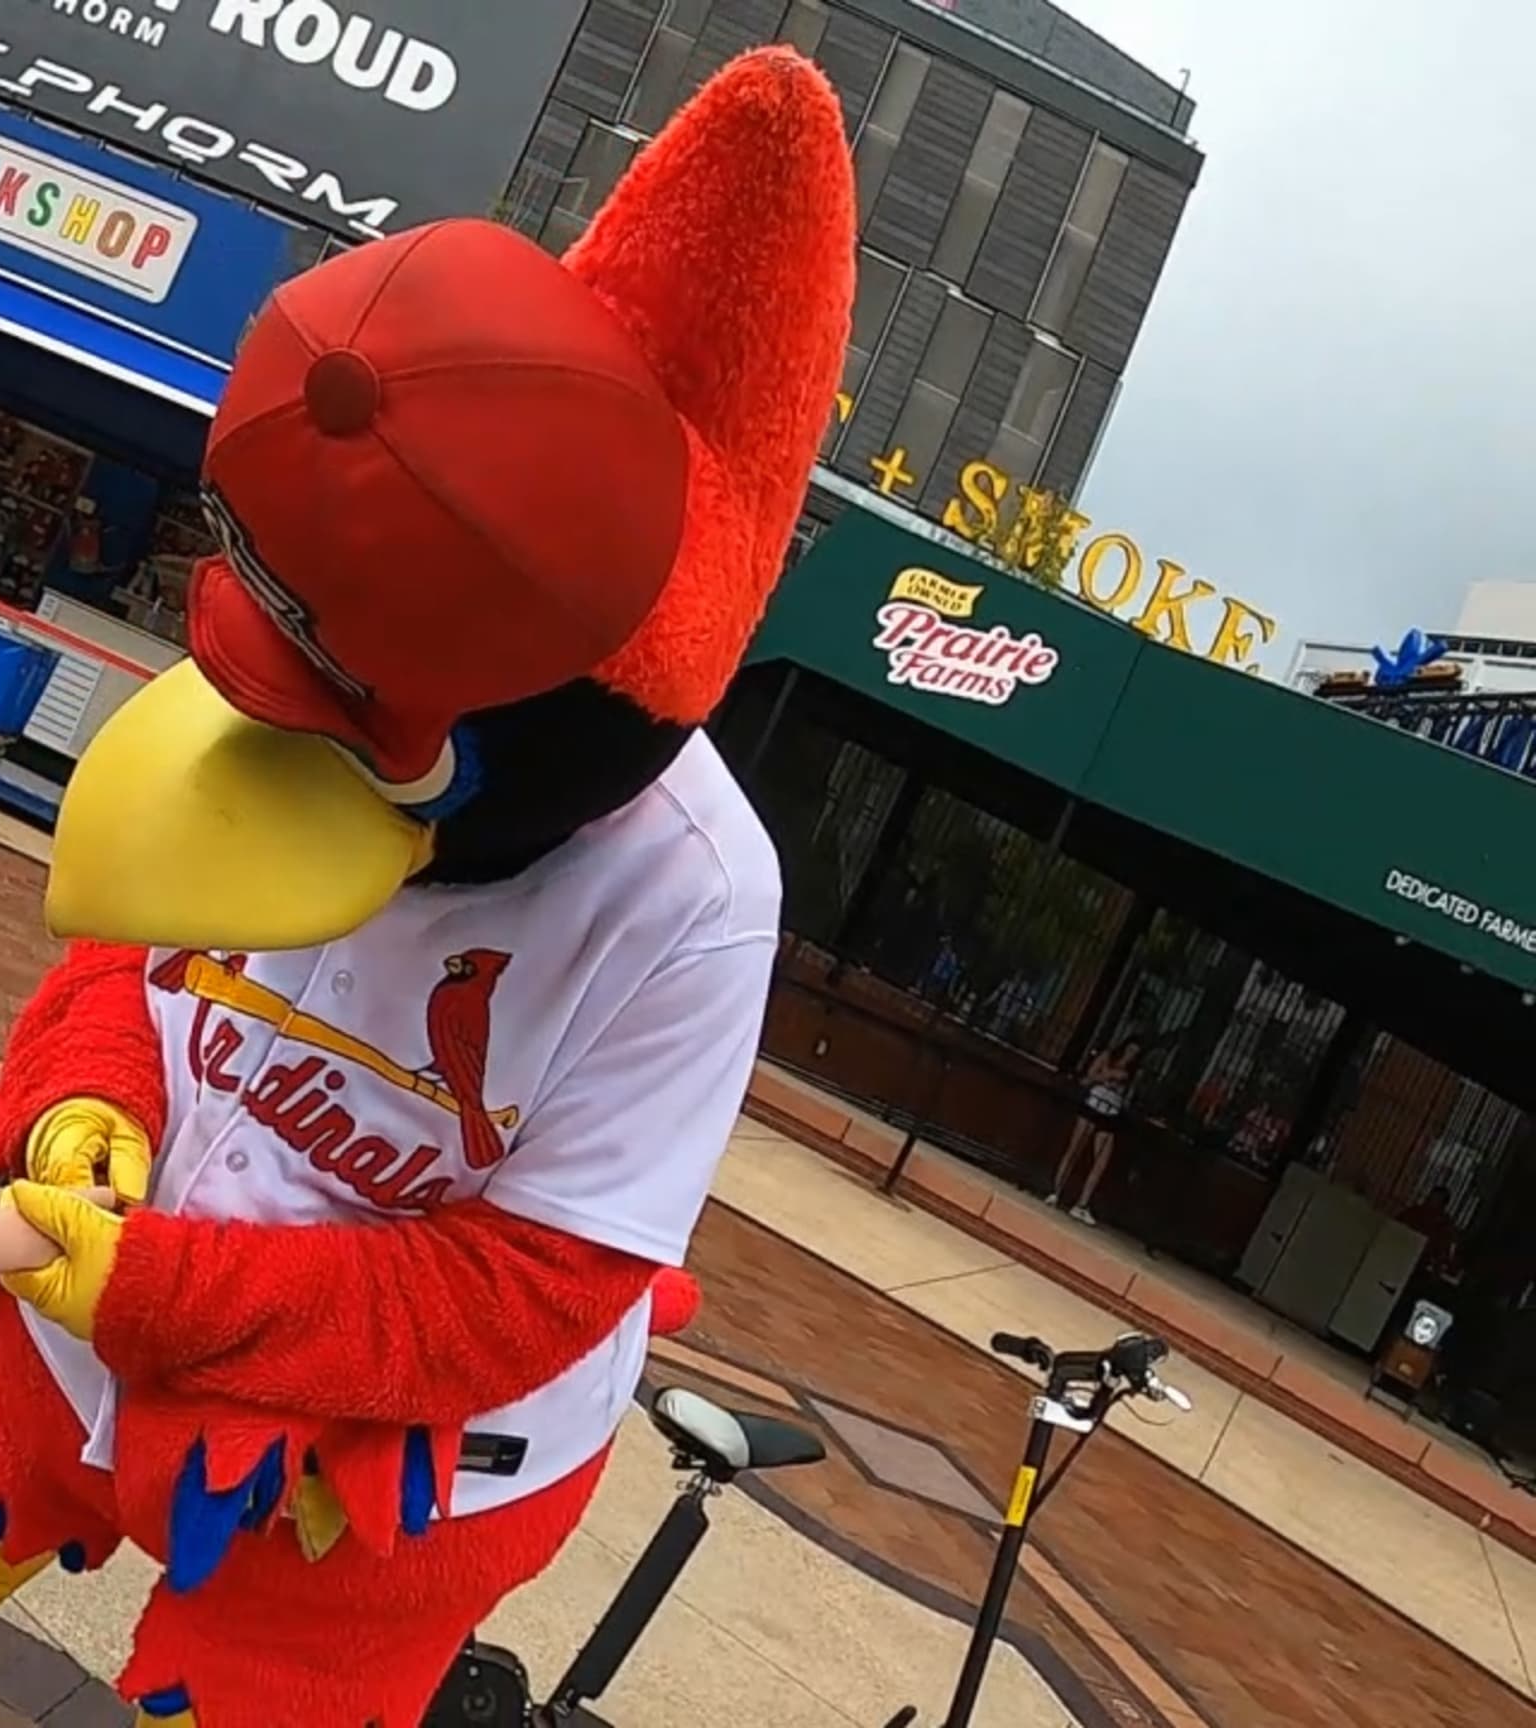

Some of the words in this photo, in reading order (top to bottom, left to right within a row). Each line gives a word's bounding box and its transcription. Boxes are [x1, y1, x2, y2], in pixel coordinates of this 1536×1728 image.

[154, 0, 458, 112] ROUD
[880, 604, 1056, 680] Prairie
[893, 649, 1012, 700] Farms
[1385, 868, 1480, 925] DEDICATED
[187, 998, 456, 1213] rdinals
